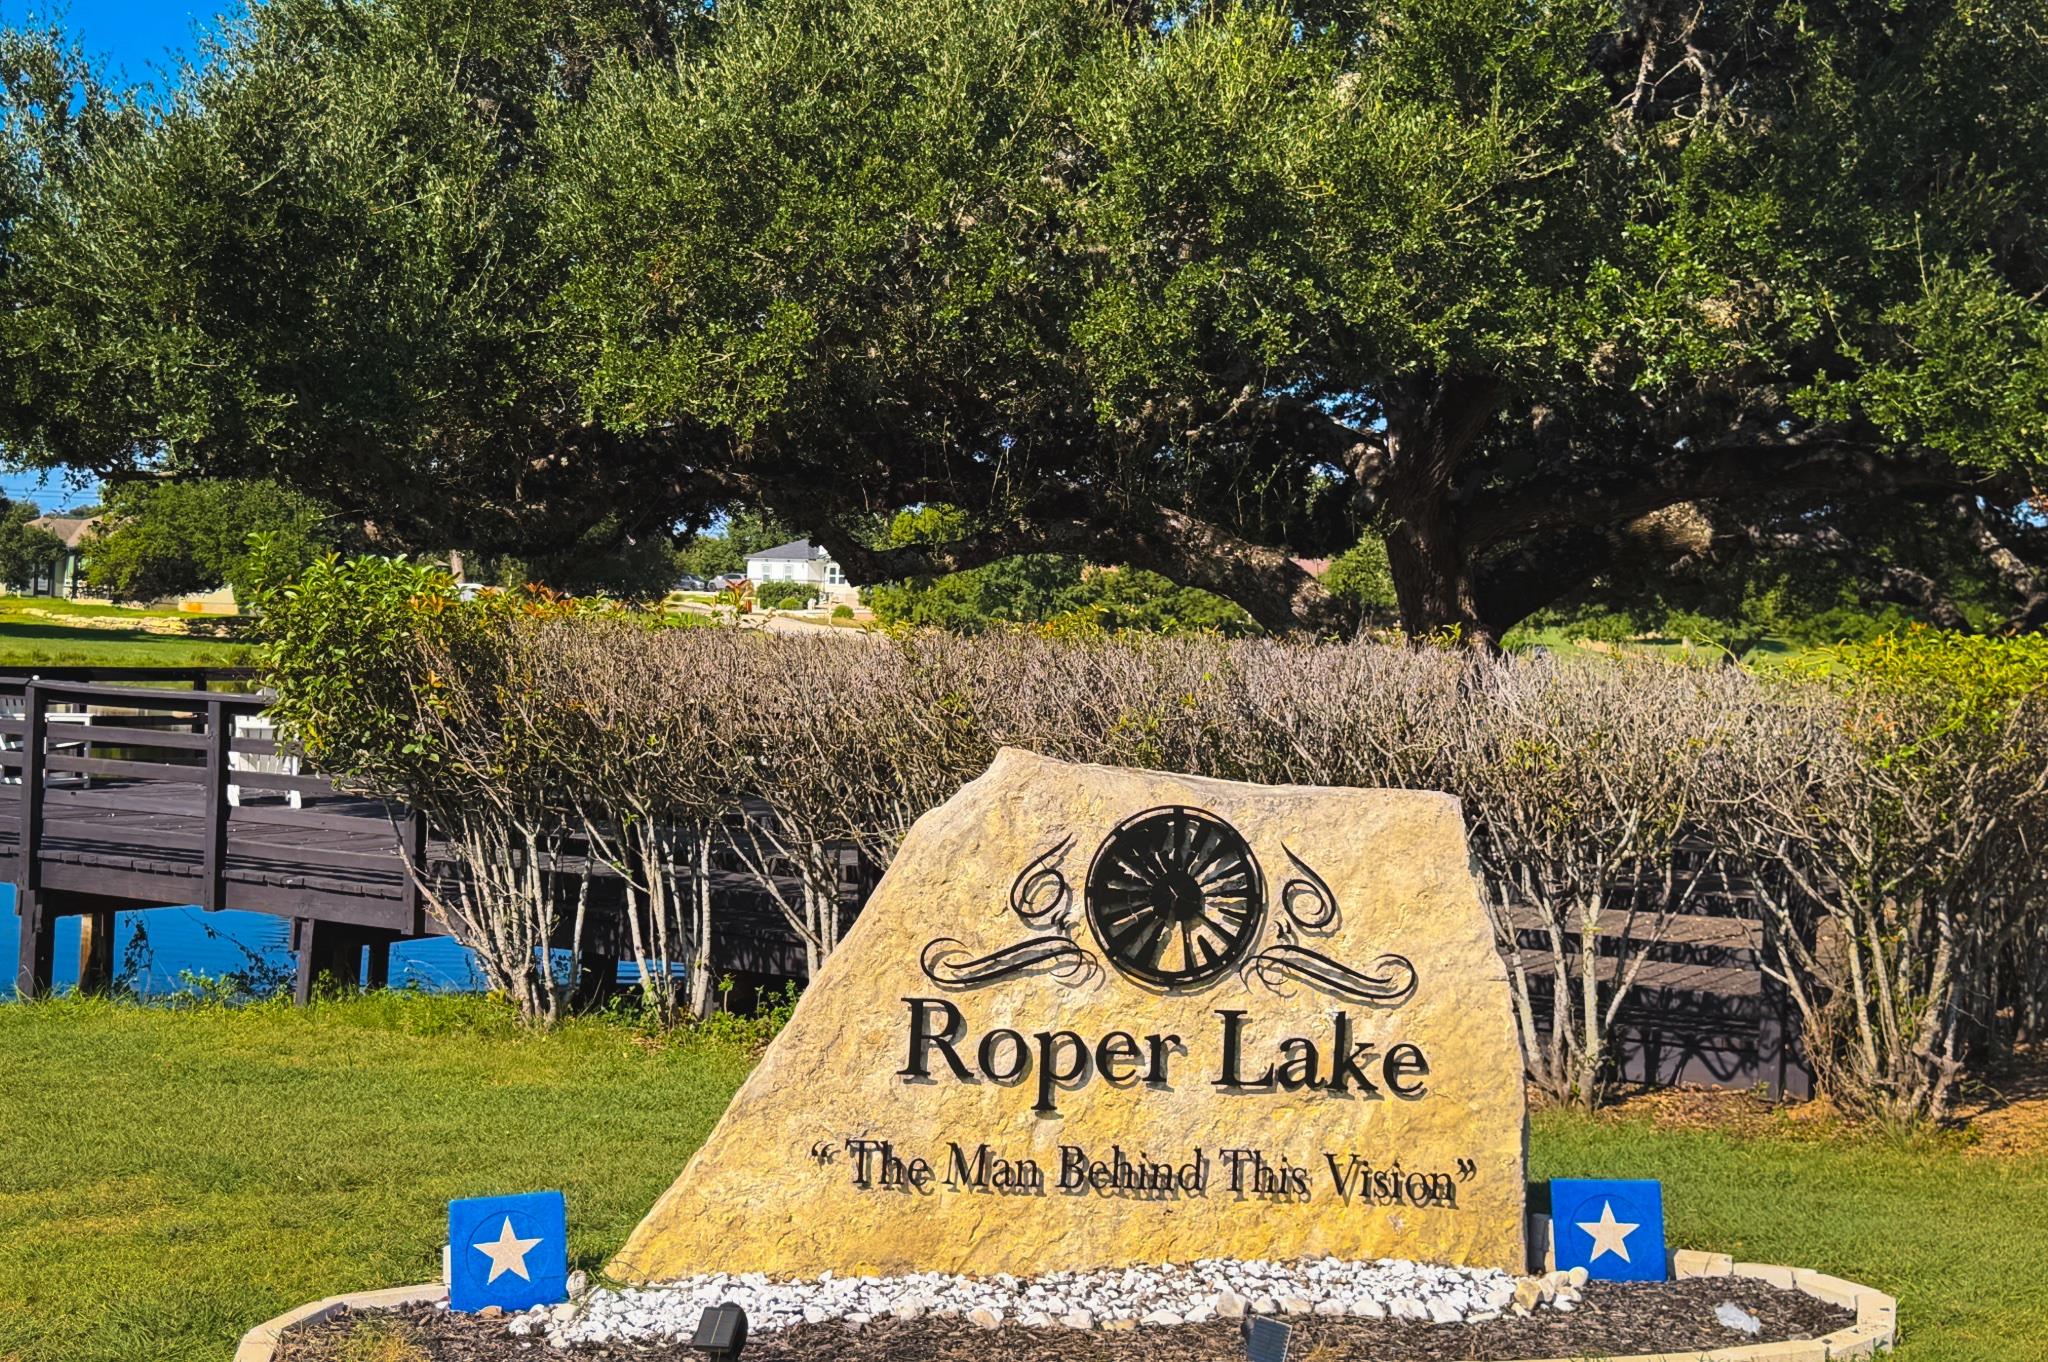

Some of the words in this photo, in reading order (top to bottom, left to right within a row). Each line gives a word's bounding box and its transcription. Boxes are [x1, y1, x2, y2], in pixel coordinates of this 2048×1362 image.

[896, 996, 1183, 1111] Roper
[1211, 1008, 1429, 1095] Lake
[810, 1138, 928, 1190] “The
[943, 1141, 1040, 1190] Man
[1055, 1144, 1203, 1193] Behind
[1218, 1147, 1309, 1195] This
[1324, 1151, 1477, 1201] Vision”
